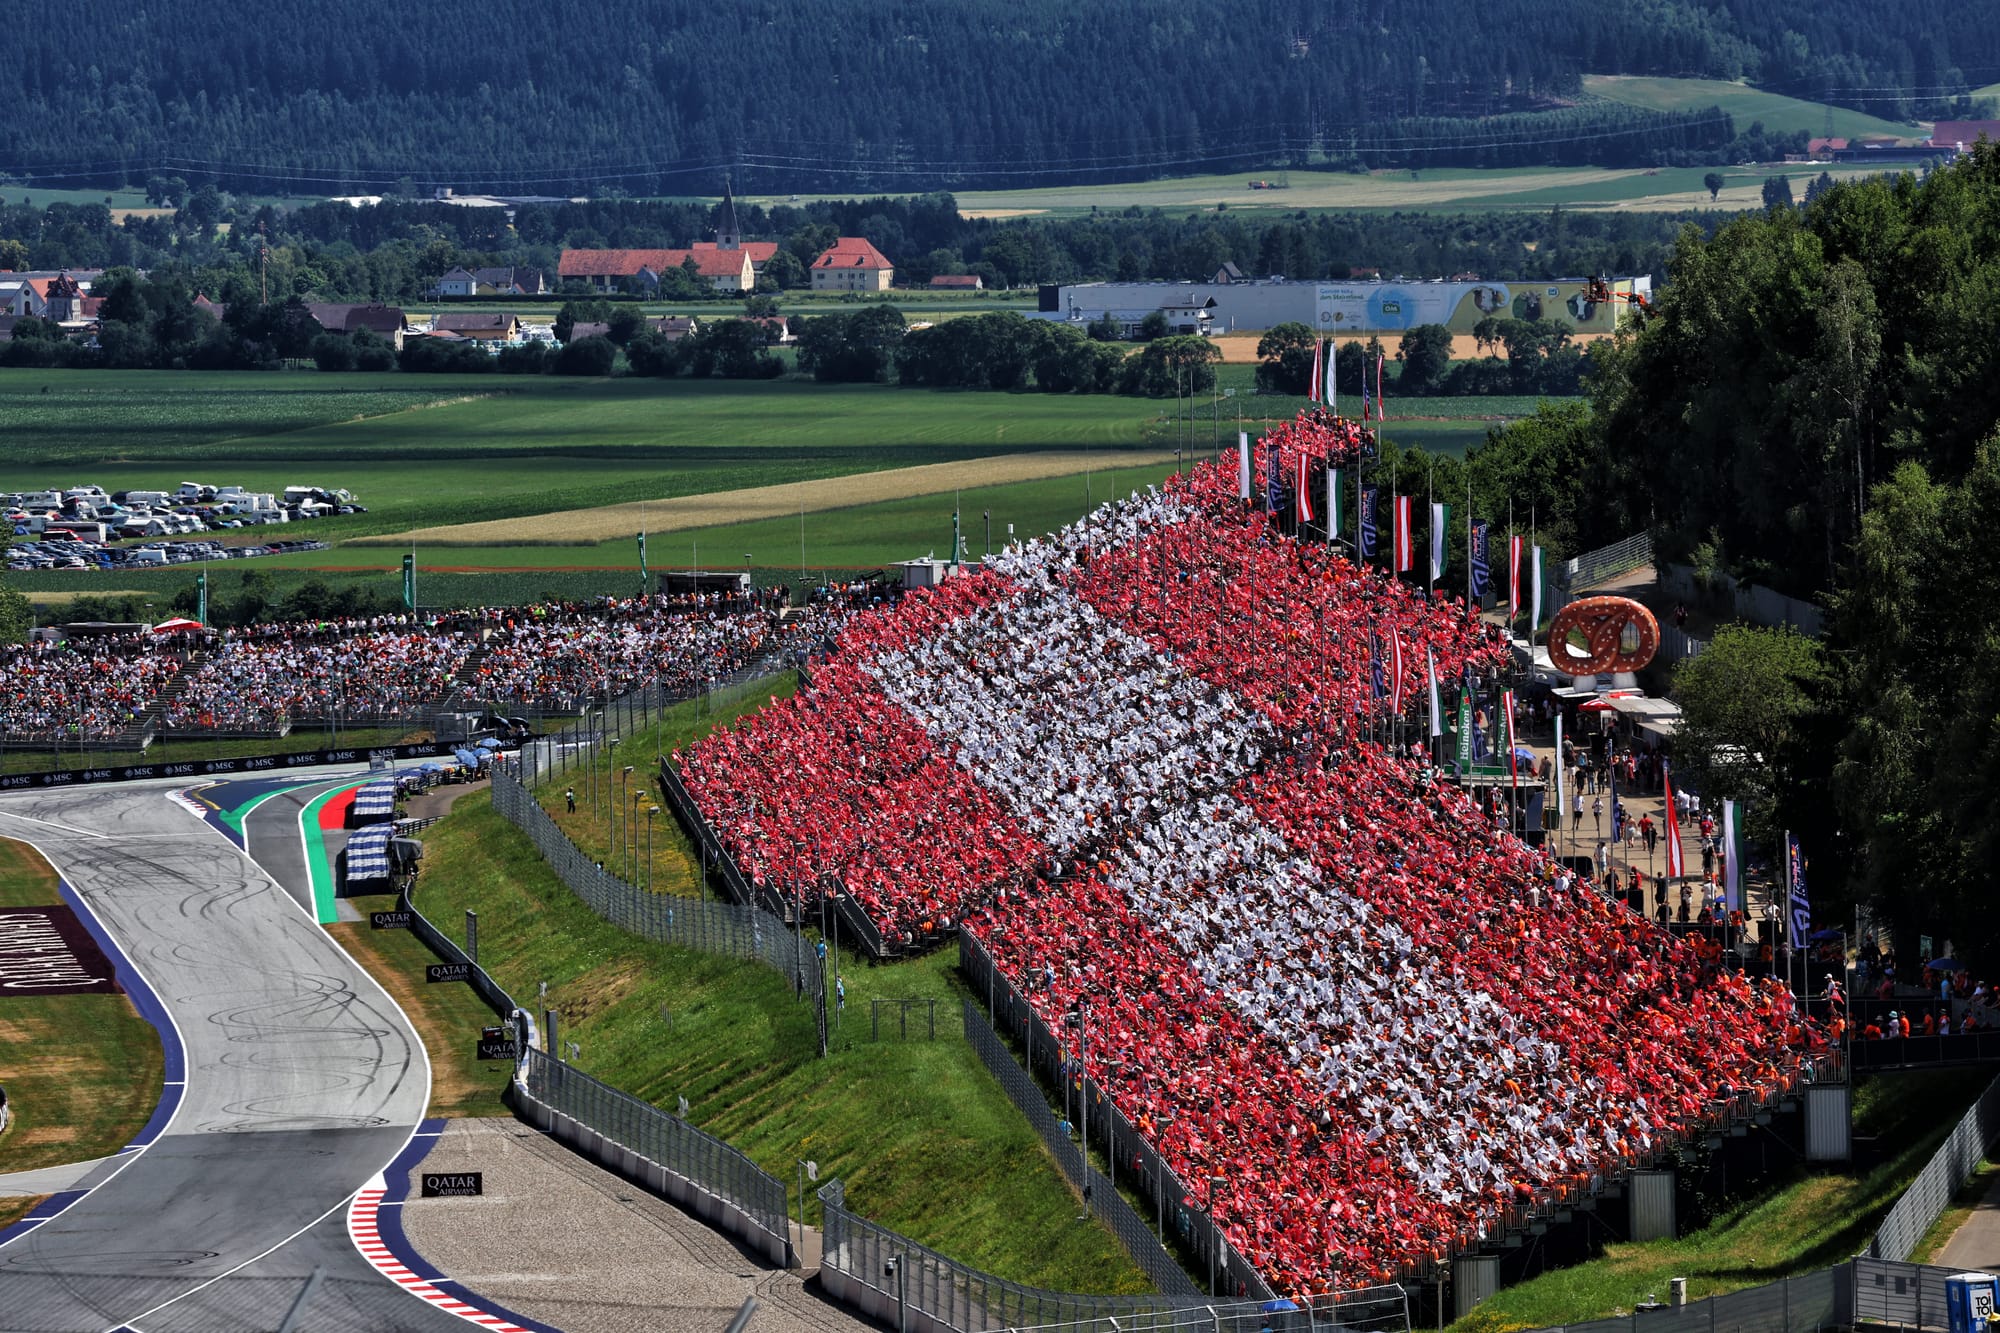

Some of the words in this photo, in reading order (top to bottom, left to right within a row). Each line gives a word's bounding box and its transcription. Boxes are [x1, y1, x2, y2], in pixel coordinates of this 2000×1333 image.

[1460, 710, 1470, 760] Heineken
[377, 749, 397, 757] MSC
[417, 745, 436, 753] MSC
[296, 755, 316, 763] MSC
[336, 751, 355, 760] MSC
[215, 761, 234, 770] MSC
[255, 758, 274, 767] MSC
[134, 767, 153, 776] MSC
[174, 764, 193, 773] MSC
[53, 773, 72, 782] MSC
[93, 770, 111, 778] MSC
[11, 776, 30, 785] MSC
[375, 913, 410, 924] QATAR
[431, 965, 468, 977] QATAR
[482, 1042, 515, 1055] QATA
[427, 1176, 475, 1190] QATAR
